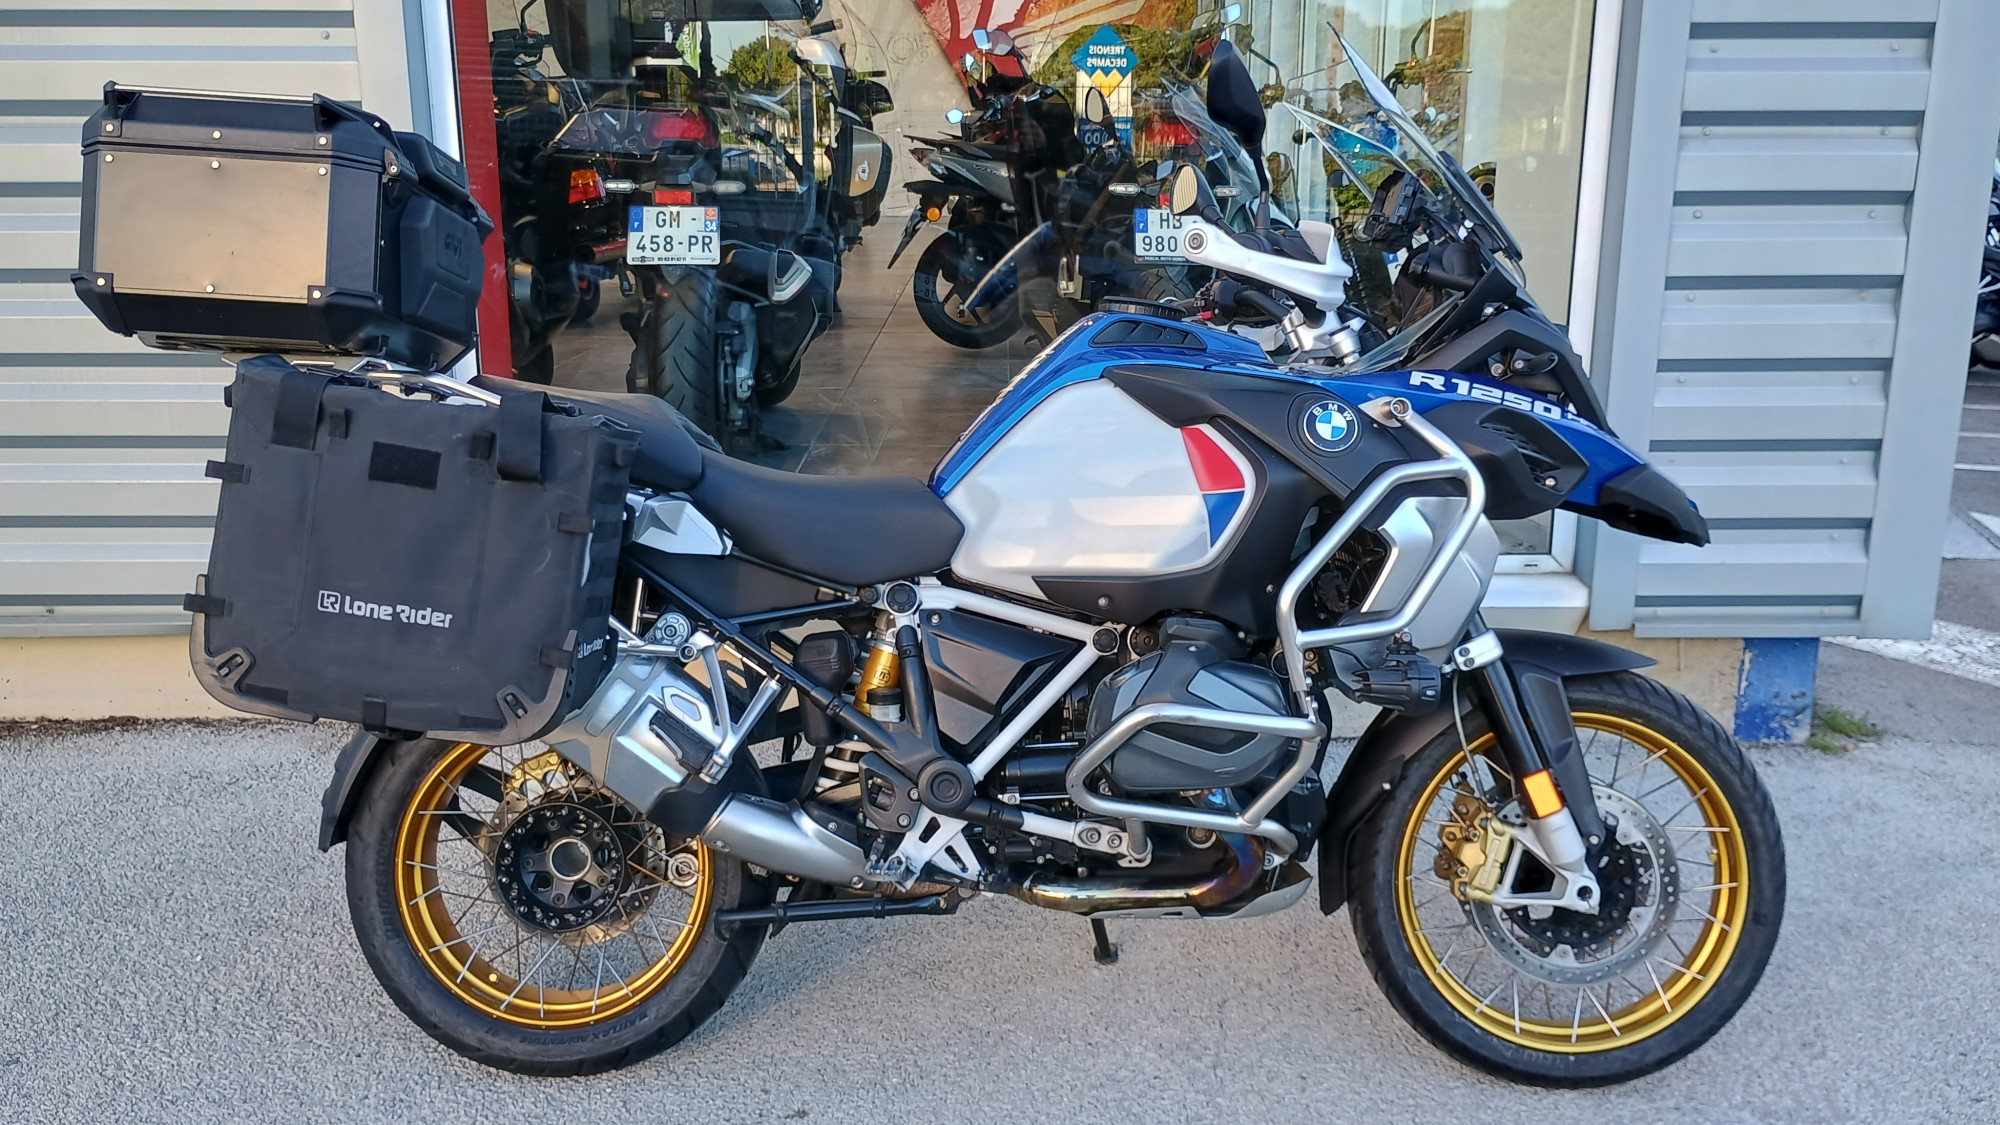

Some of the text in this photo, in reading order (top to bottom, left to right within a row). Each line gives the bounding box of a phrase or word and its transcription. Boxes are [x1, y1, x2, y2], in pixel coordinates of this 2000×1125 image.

[656, 210, 680, 228] GM
[705, 221, 717, 231] 34
[636, 235, 713, 253] 458-PR
[1409, 371, 1562, 420] R 1250
[1312, 403, 1353, 421] BMW
[344, 595, 393, 621] Lone
[396, 604, 453, 628] Rider
